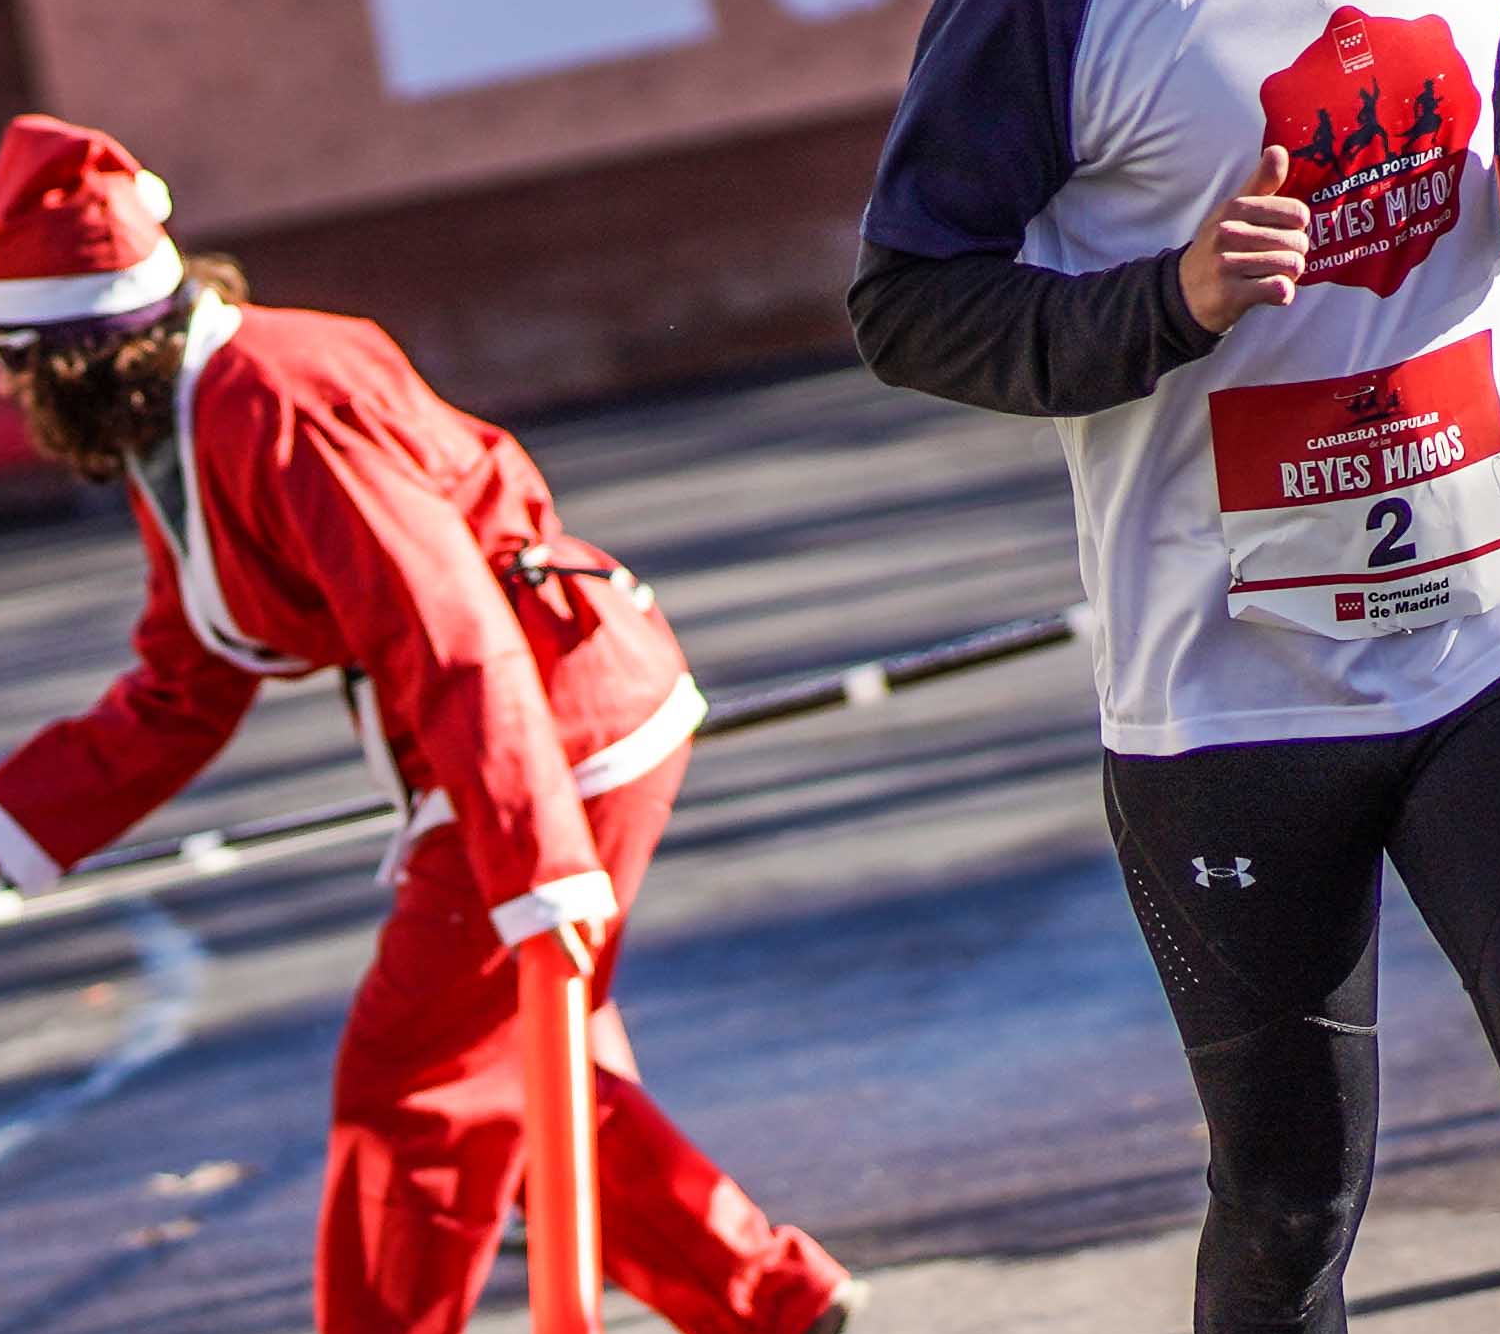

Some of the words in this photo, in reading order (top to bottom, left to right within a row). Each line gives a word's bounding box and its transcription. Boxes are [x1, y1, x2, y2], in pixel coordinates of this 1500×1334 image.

[1312, 168, 1379, 203] CARRERA
[1382, 146, 1444, 180] POPULAR
[1306, 427, 1378, 450] CARRERA
[1381, 411, 1440, 435] POPULAR
[1279, 453, 1371, 498] REYES
[1381, 424, 1465, 485] MAGOS
[1365, 497, 1417, 568] 2
[1368, 577, 1450, 603] Comunidad
[1369, 605, 1391, 619] de
[1394, 591, 1450, 615] Madrid
